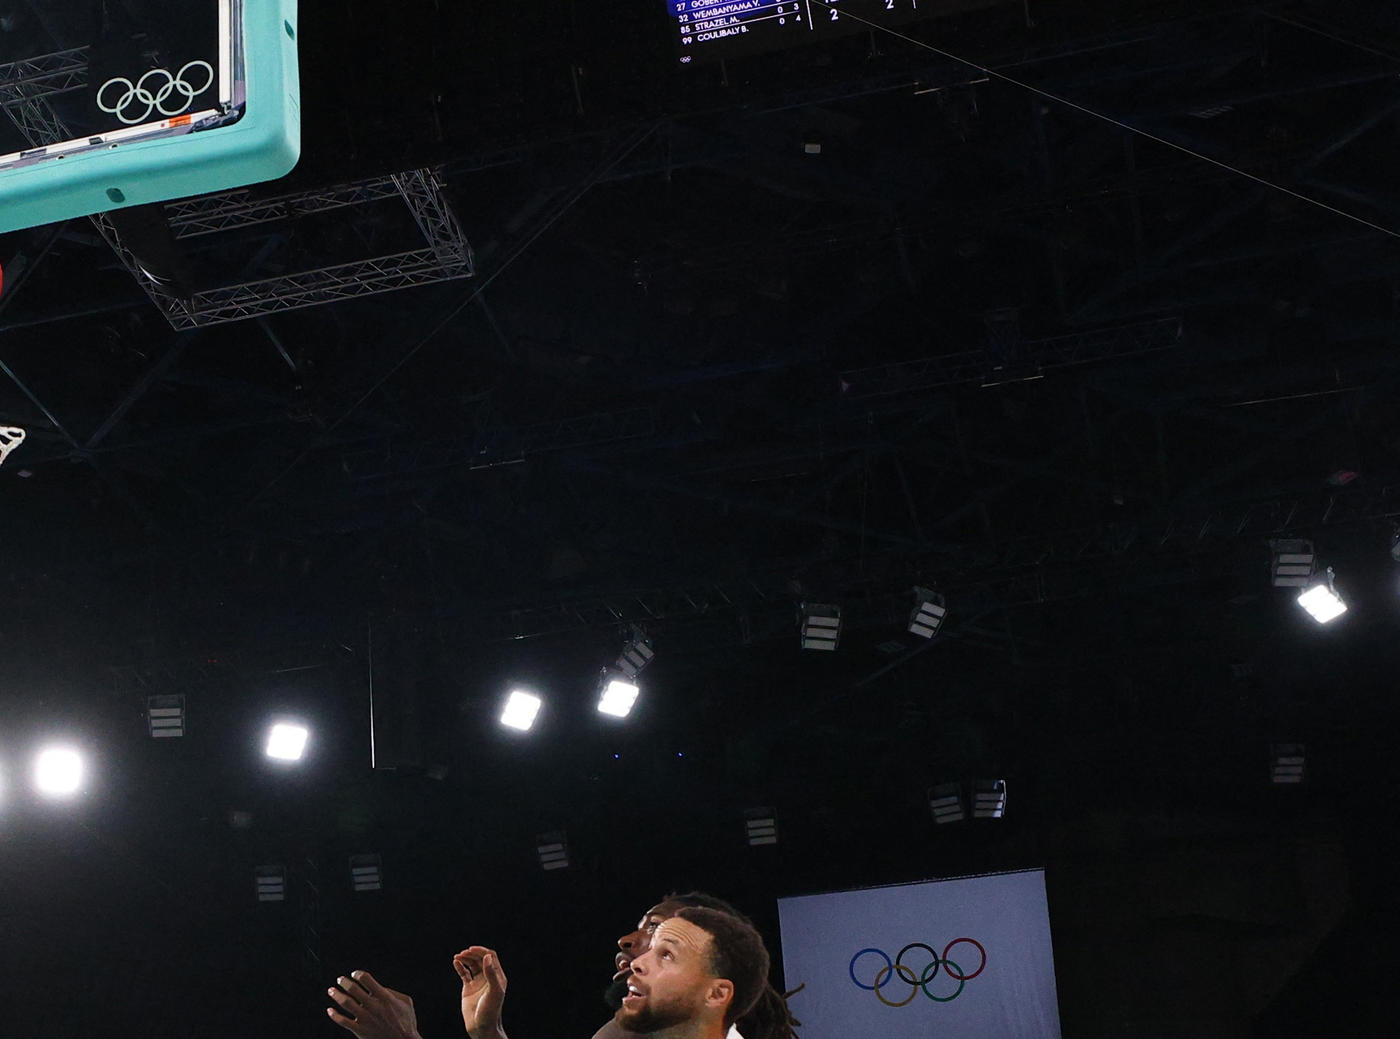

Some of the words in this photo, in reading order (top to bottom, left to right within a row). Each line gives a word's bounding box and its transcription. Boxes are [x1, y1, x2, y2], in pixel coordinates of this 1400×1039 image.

[676, 3, 686, 12] 27
[678, 14, 689, 23] 32
[692, 2, 752, 20] WEMBANYAMA
[830, 9, 839, 21] 2
[680, 26, 691, 34] 85
[694, 17, 730, 31] STRAZEL
[729, 15, 741, 24] M.
[681, 35, 693, 45] 99
[696, 27, 741, 42] COULIBALY
